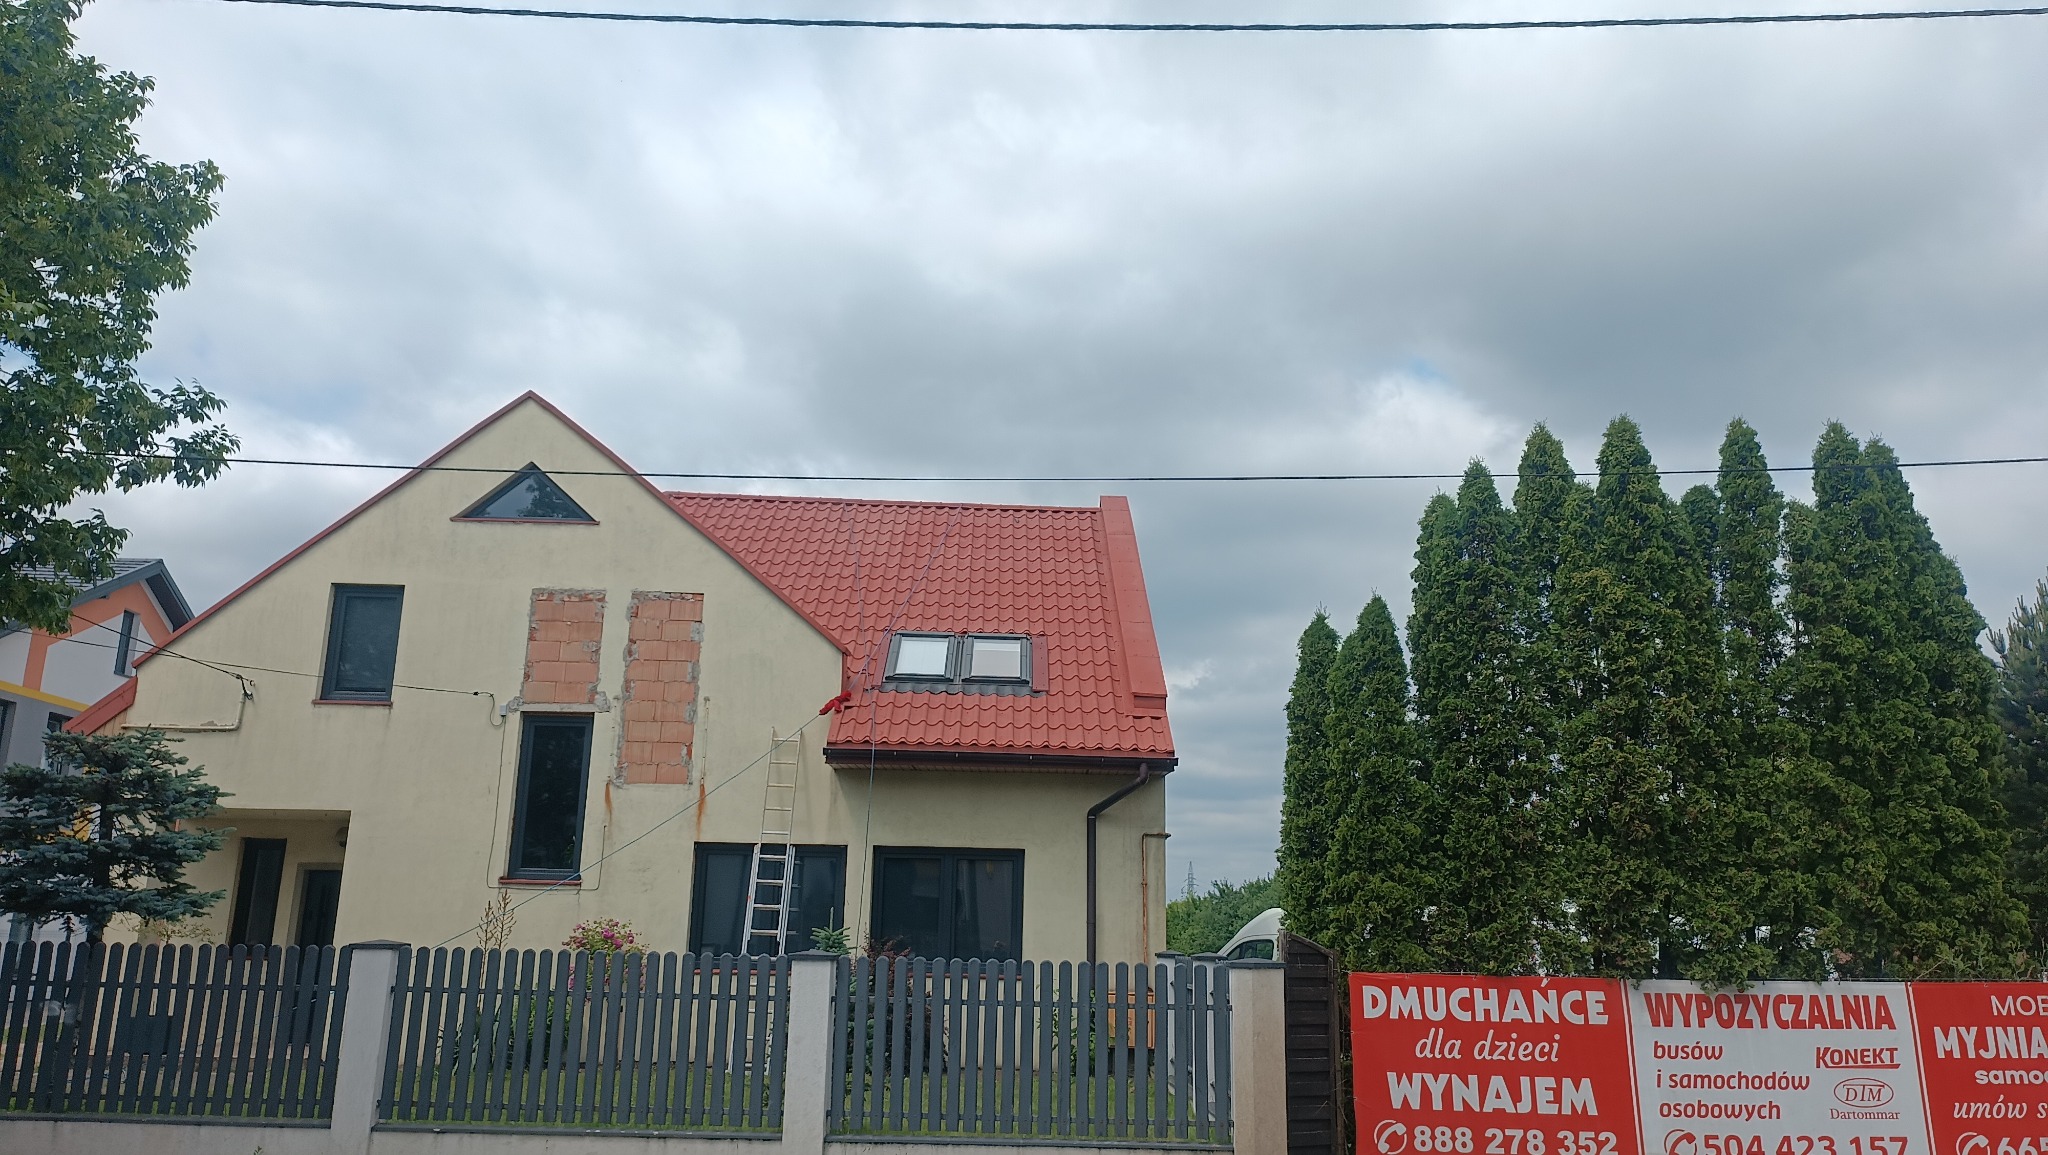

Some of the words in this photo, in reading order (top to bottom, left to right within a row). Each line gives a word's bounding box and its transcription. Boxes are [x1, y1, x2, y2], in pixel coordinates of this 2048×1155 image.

[1362, 978, 1610, 1025] DMUCHAŃCE
[1643, 989, 1897, 1030] WYPOŻYCZALNIA
[1415, 1027, 1462, 1060] dla
[1473, 1029, 1561, 1062] dzieci
[1653, 1040, 1723, 1061] busów
[1933, 1026, 2048, 1060] MYJNIA
[1815, 1046, 1900, 1069] KONEKT
[1655, 1069, 1662, 1089] i
[1668, 1070, 1811, 1091] samochodów
[1386, 1071, 1599, 1116] WYNAJEM
[1842, 1083, 1886, 1102] DTM
[1659, 1099, 1781, 1121] osobowych
[1829, 1108, 1901, 1120] Dartommar
[1953, 1094, 2028, 1119] umów
[1413, 1125, 1474, 1153] 888
[1484, 1127, 1546, 1155] 278
[1556, 1130, 1619, 1155] 352
[1703, 1134, 1766, 1155] 504
[1775, 1135, 1838, 1155] 423
[1849, 1136, 1909, 1155] 157
